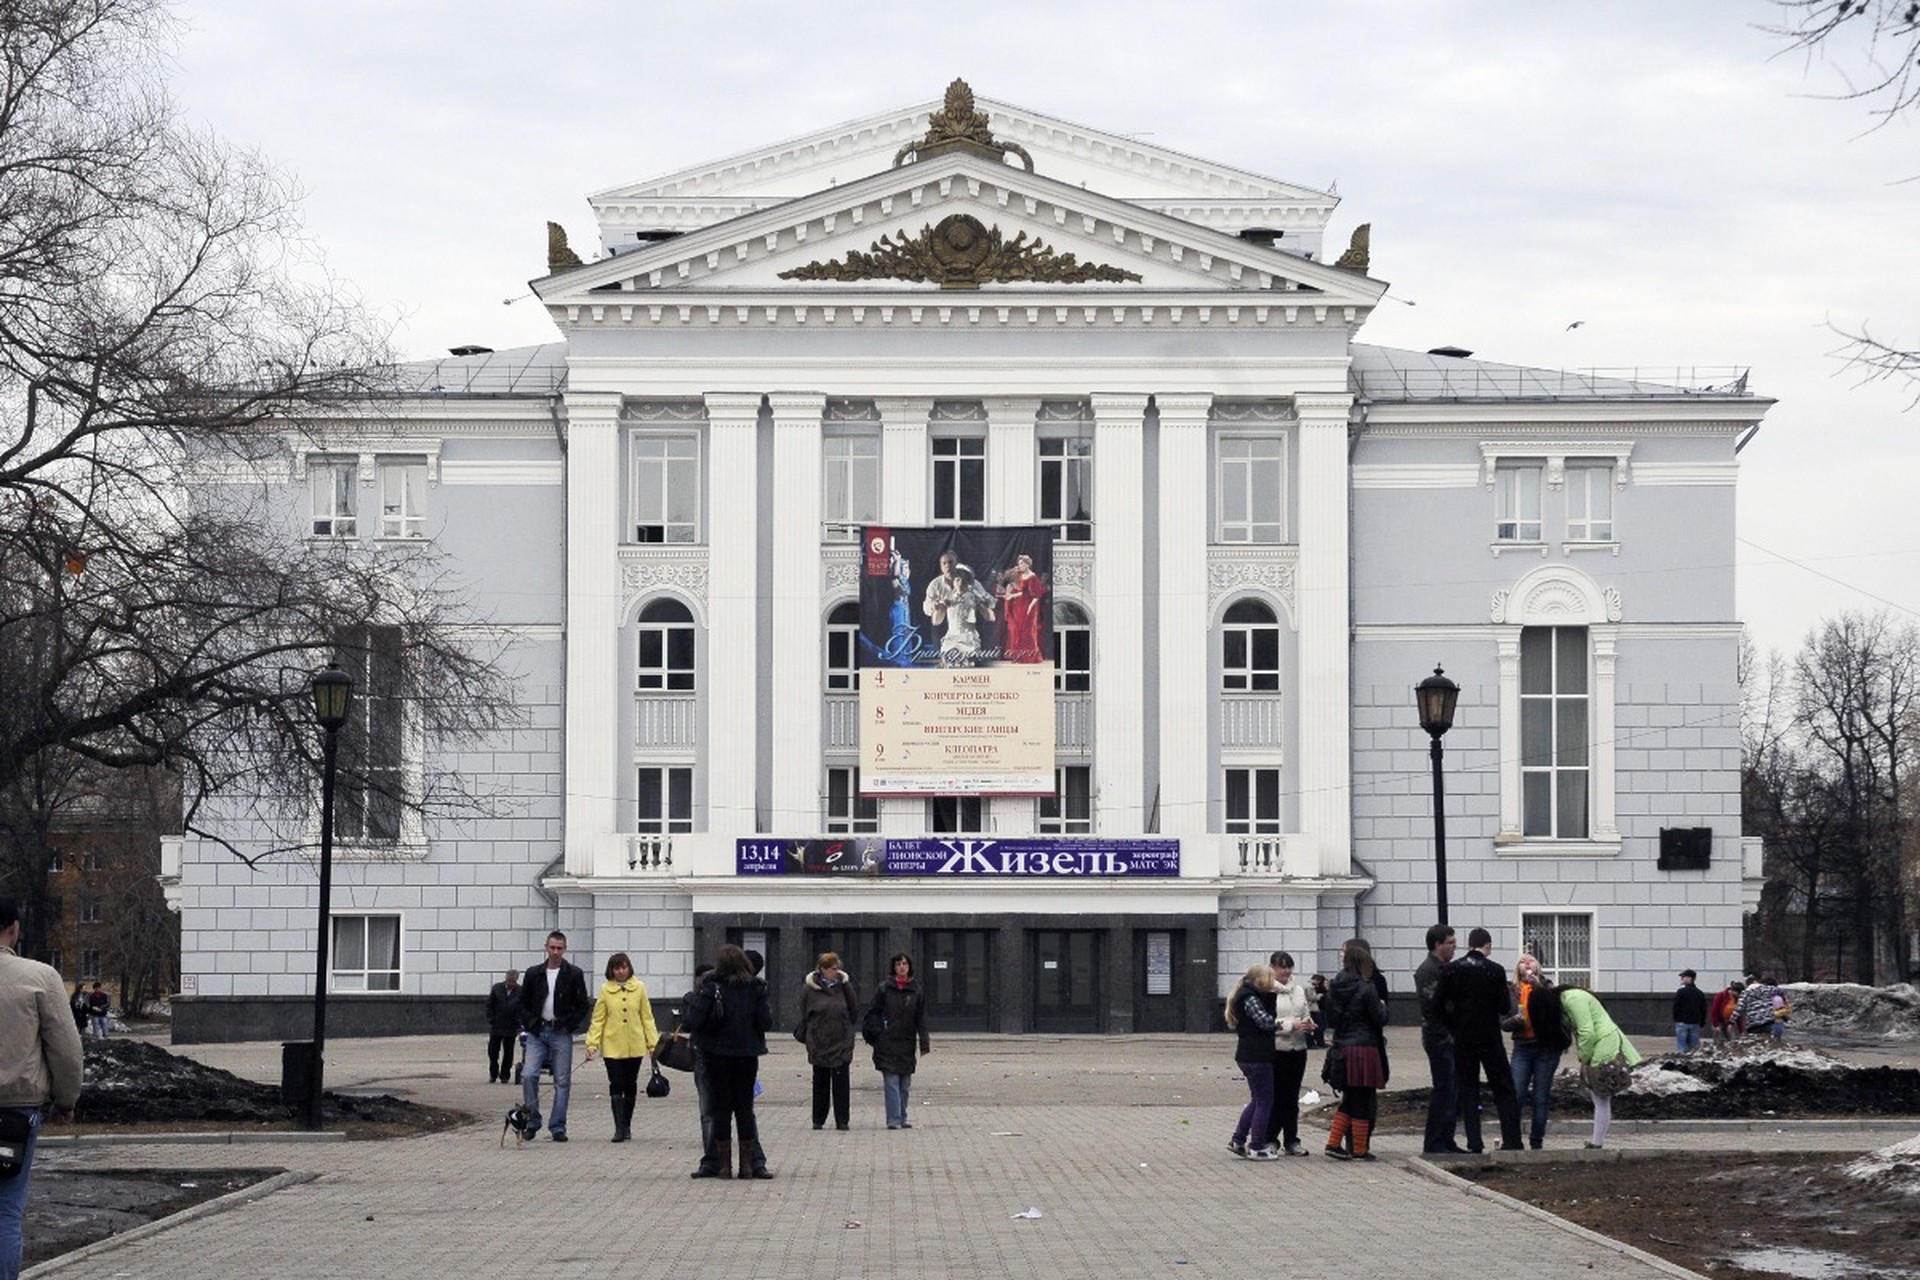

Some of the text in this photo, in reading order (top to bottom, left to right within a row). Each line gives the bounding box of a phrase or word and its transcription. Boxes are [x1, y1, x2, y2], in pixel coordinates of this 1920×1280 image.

[875, 670, 884, 684] 4
[952, 674, 990, 684] КАРМЕН
[876, 705, 885, 719] 8
[956, 706, 987, 716] МЕДЕЯ
[876, 743, 885, 758] 9
[888, 841, 922, 850] БАЛЕТ
[741, 844, 780, 863] 13,14
[887, 850, 947, 860] ЛИОНСКОЙ
[937, 840, 1128, 875] Жизель
[888, 861, 926, 870] ОПЕРЫ
[1129, 860, 1178, 869] МАТС ЭК
